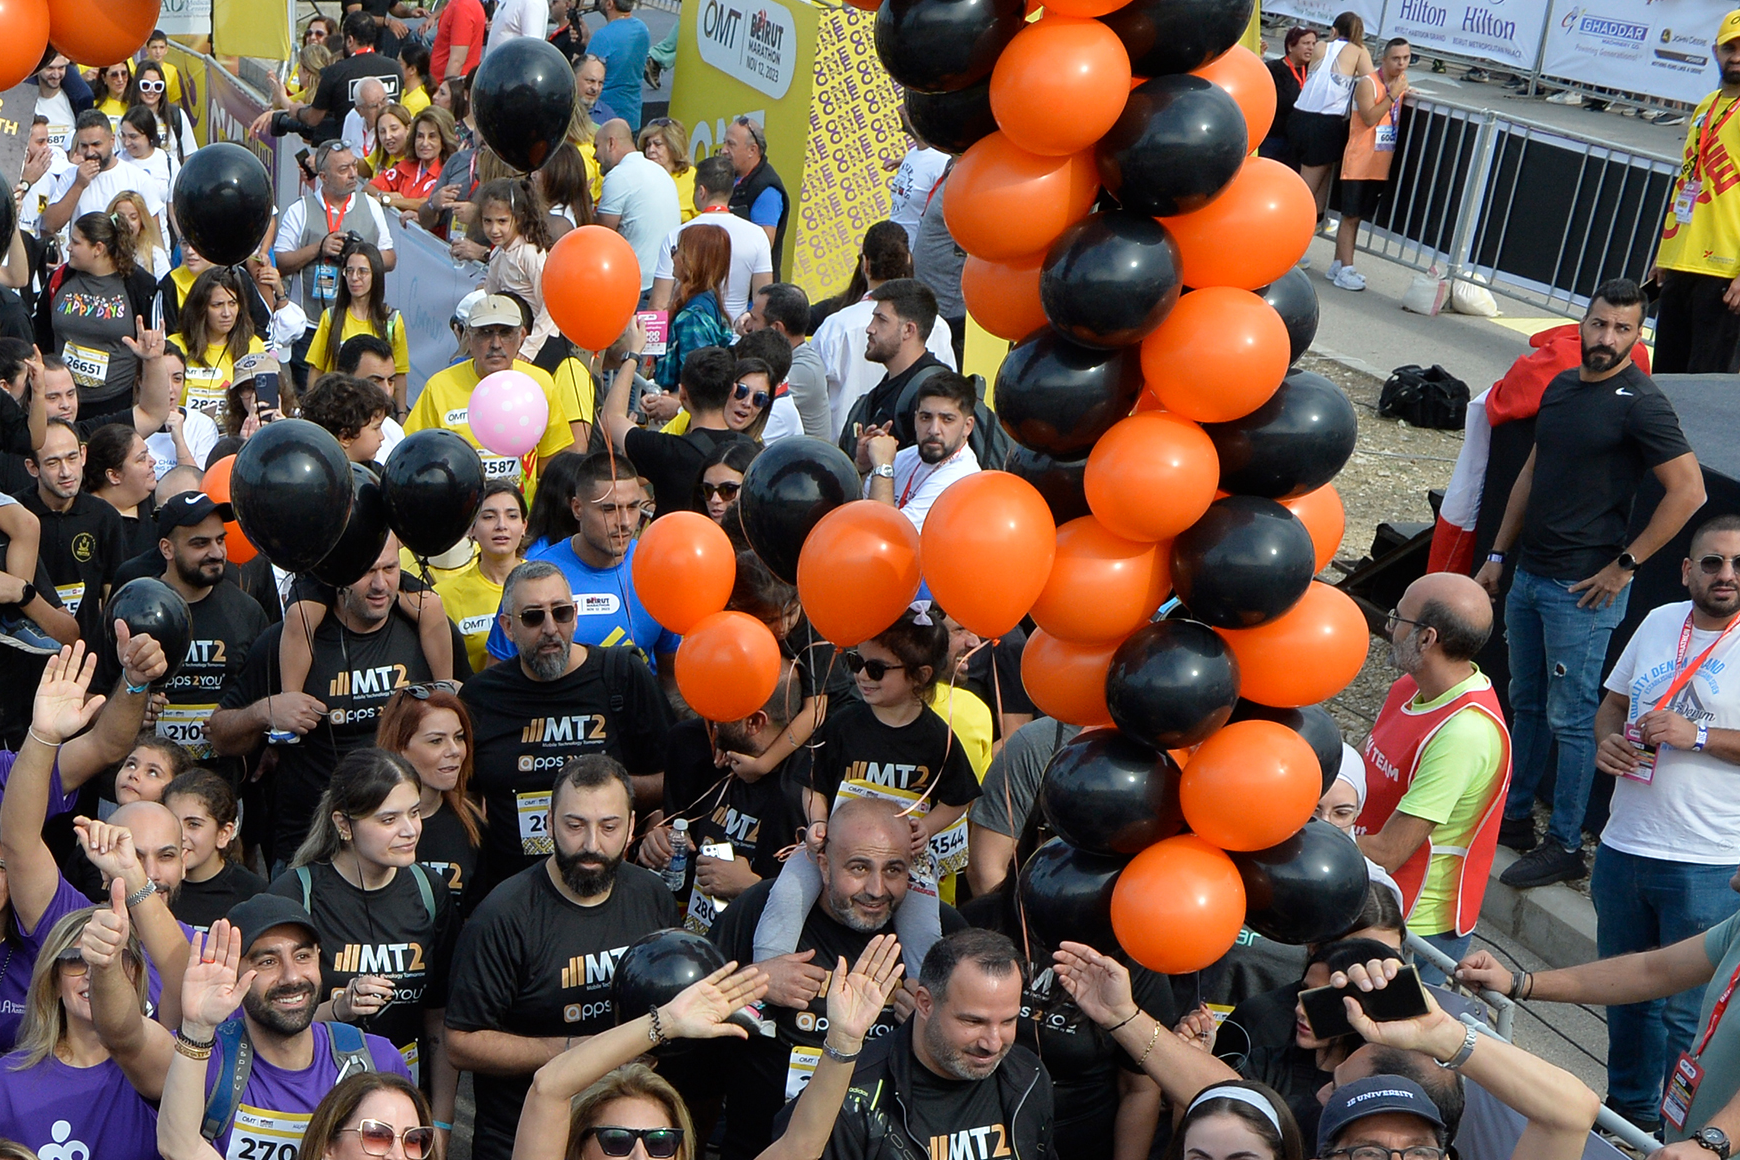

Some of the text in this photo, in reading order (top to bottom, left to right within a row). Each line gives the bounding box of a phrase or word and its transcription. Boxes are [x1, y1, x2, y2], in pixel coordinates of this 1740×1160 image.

[703, 0, 742, 49] OMT
[1400, 0, 1447, 27] Hilton
[1462, 6, 1516, 41] Hilton
[749, 13, 784, 50] BEIRUT
[1582, 19, 1645, 41] GHADDAR
[1671, 33, 1709, 48] JOHN DEERE
[748, 39, 781, 66] MARATHON
[746, 56, 758, 72] NOV
[765, 65, 779, 84] 2023
[57, 301, 125, 320] HAPPY DAYS
[67, 355, 101, 375] 26651
[586, 597, 610, 606] BEIRUT
[462, 618, 486, 631] OMT
[192, 675, 223, 687] 2YOU
[351, 663, 410, 696] MT2
[1630, 674, 1649, 719] QUALITY
[330, 706, 376, 726] apps
[542, 713, 606, 744] MT2
[518, 754, 564, 773] apps
[865, 761, 930, 790] MT2
[1371, 747, 1399, 782] TEAM
[359, 942, 426, 974] MT2
[585, 946, 629, 983] MT
[564, 999, 612, 1023] apps
[234, 1041, 248, 1092] Osprey
[848, 1086, 869, 1098] adidas
[1357, 1089, 1414, 1103] UNIVERSITY
[241, 1115, 257, 1124] OMT
